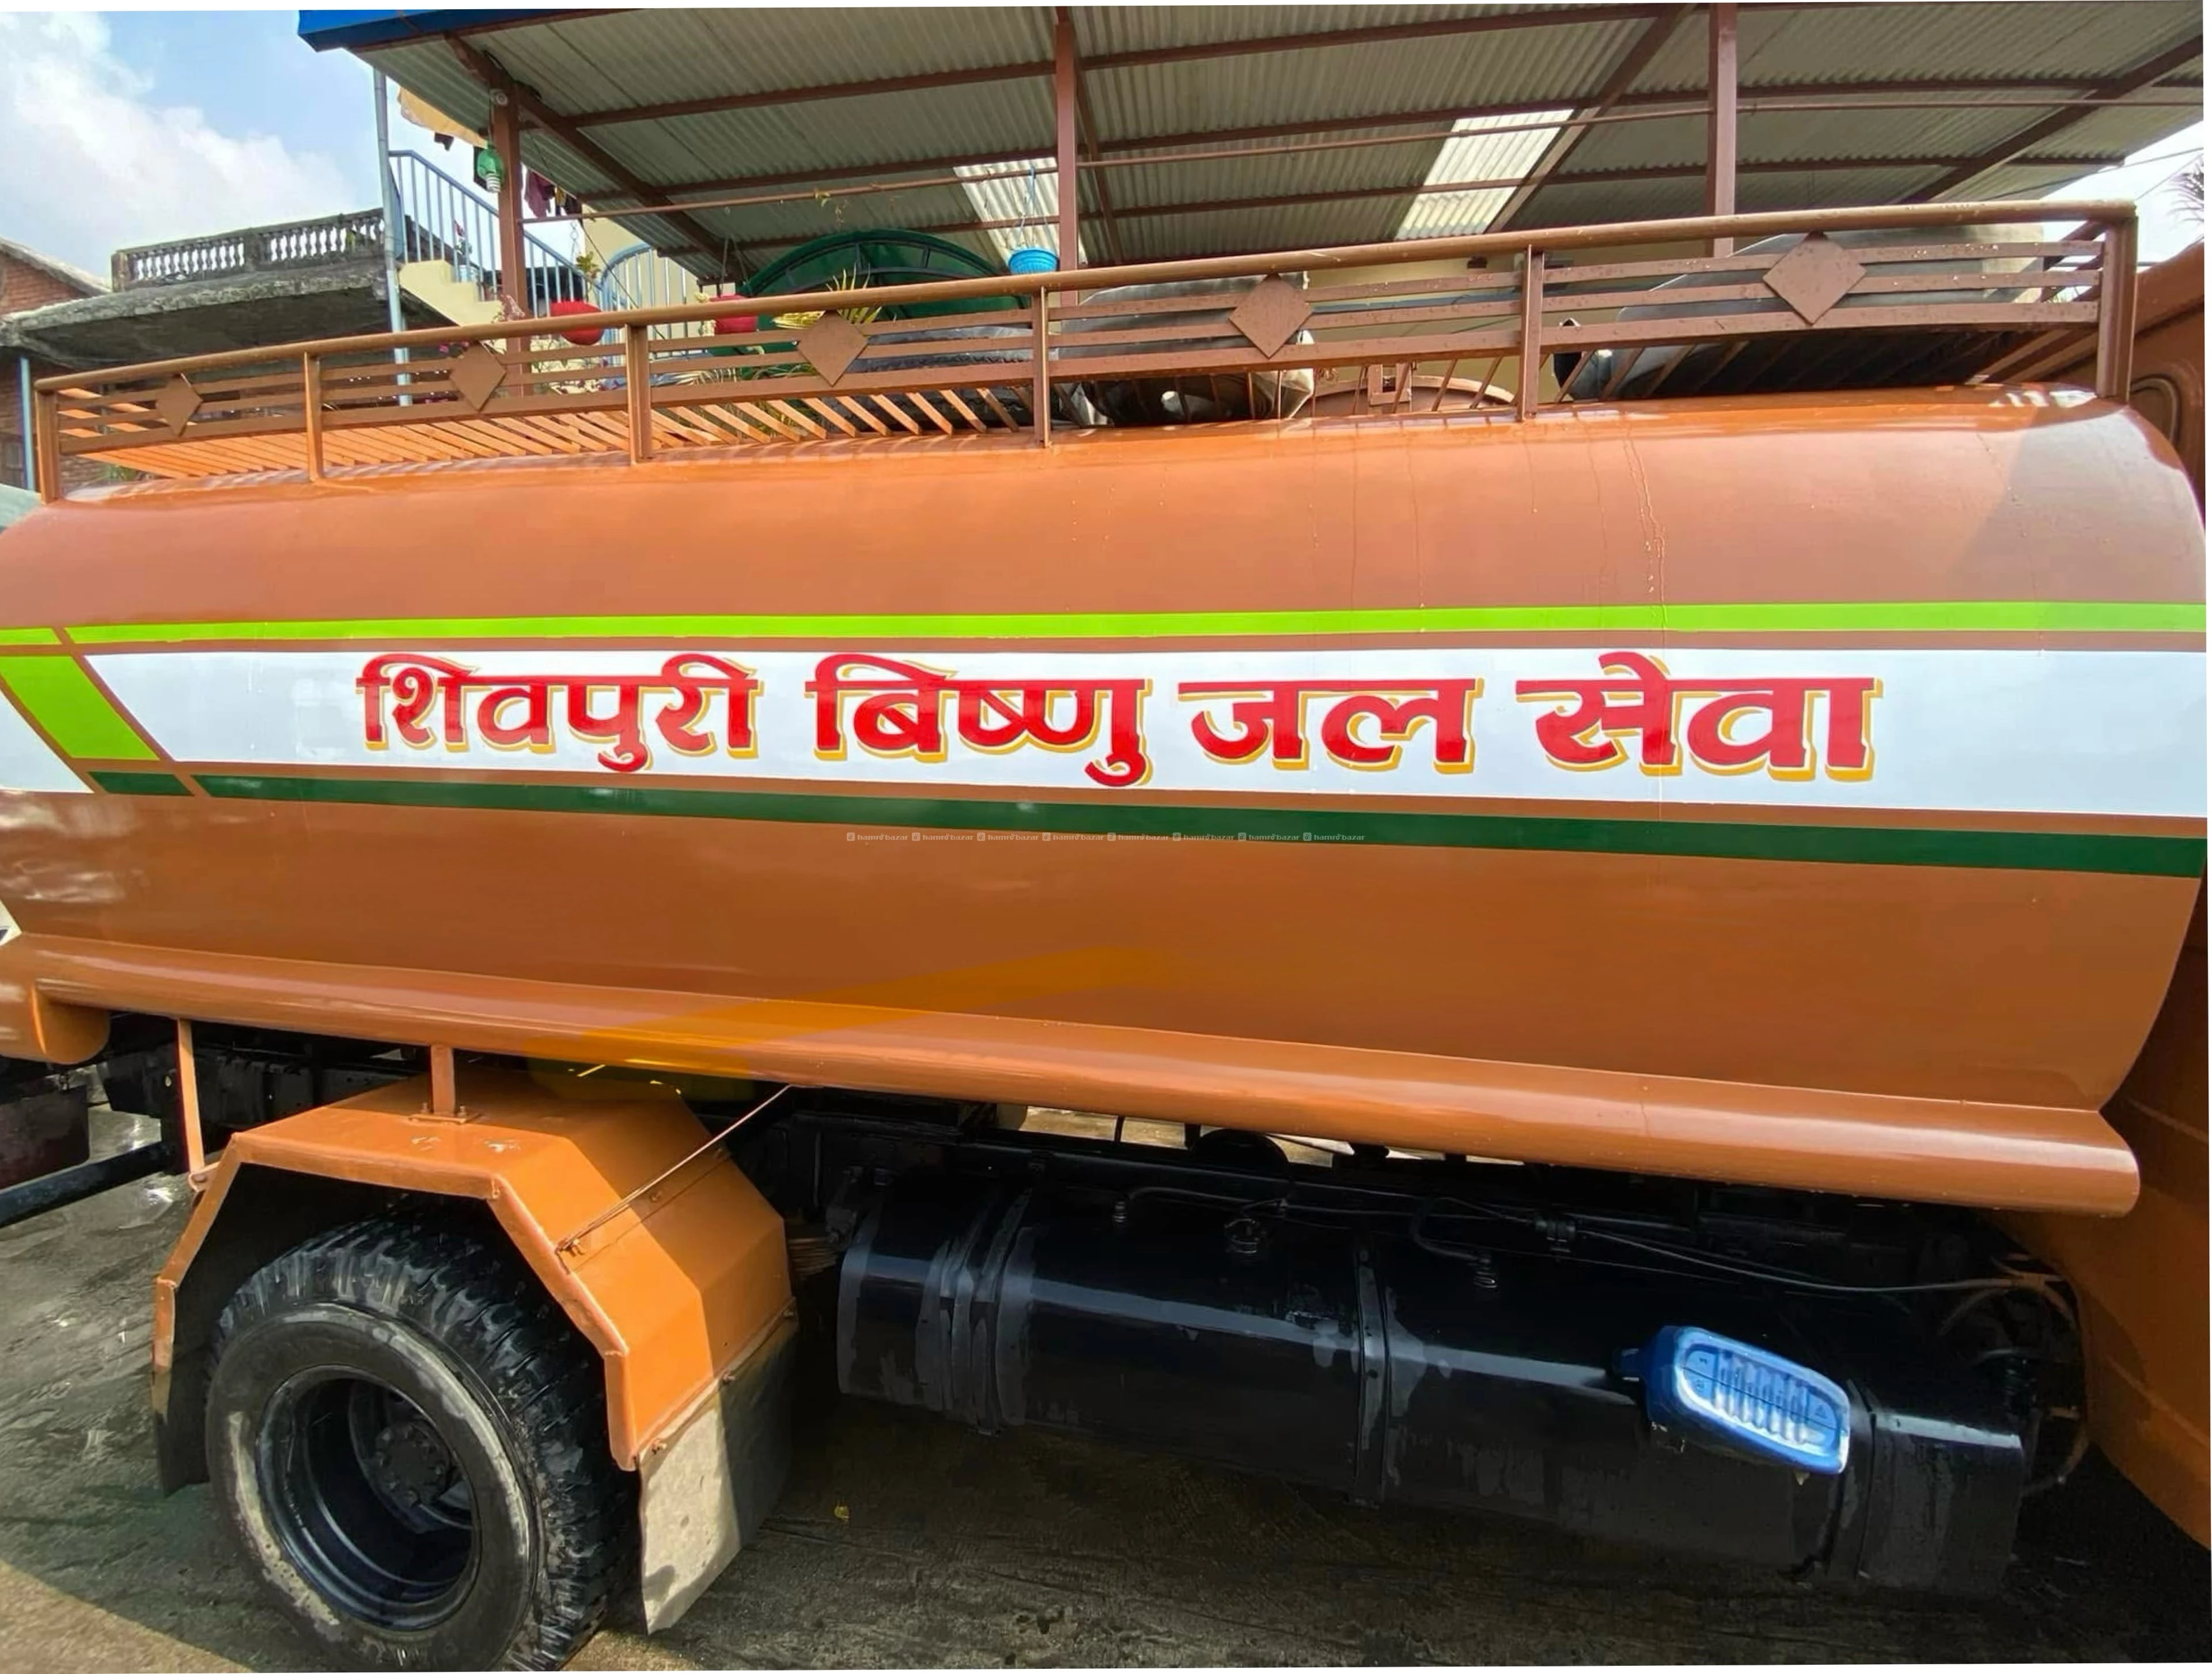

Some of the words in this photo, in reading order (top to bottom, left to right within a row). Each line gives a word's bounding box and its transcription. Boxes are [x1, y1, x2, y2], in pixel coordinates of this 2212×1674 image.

[355, 653, 765, 773] शिवपुरी
[805, 653, 1153, 787] बिष्णु
[1178, 678, 1484, 774] जल
[1516, 652, 1883, 782] सेवा
